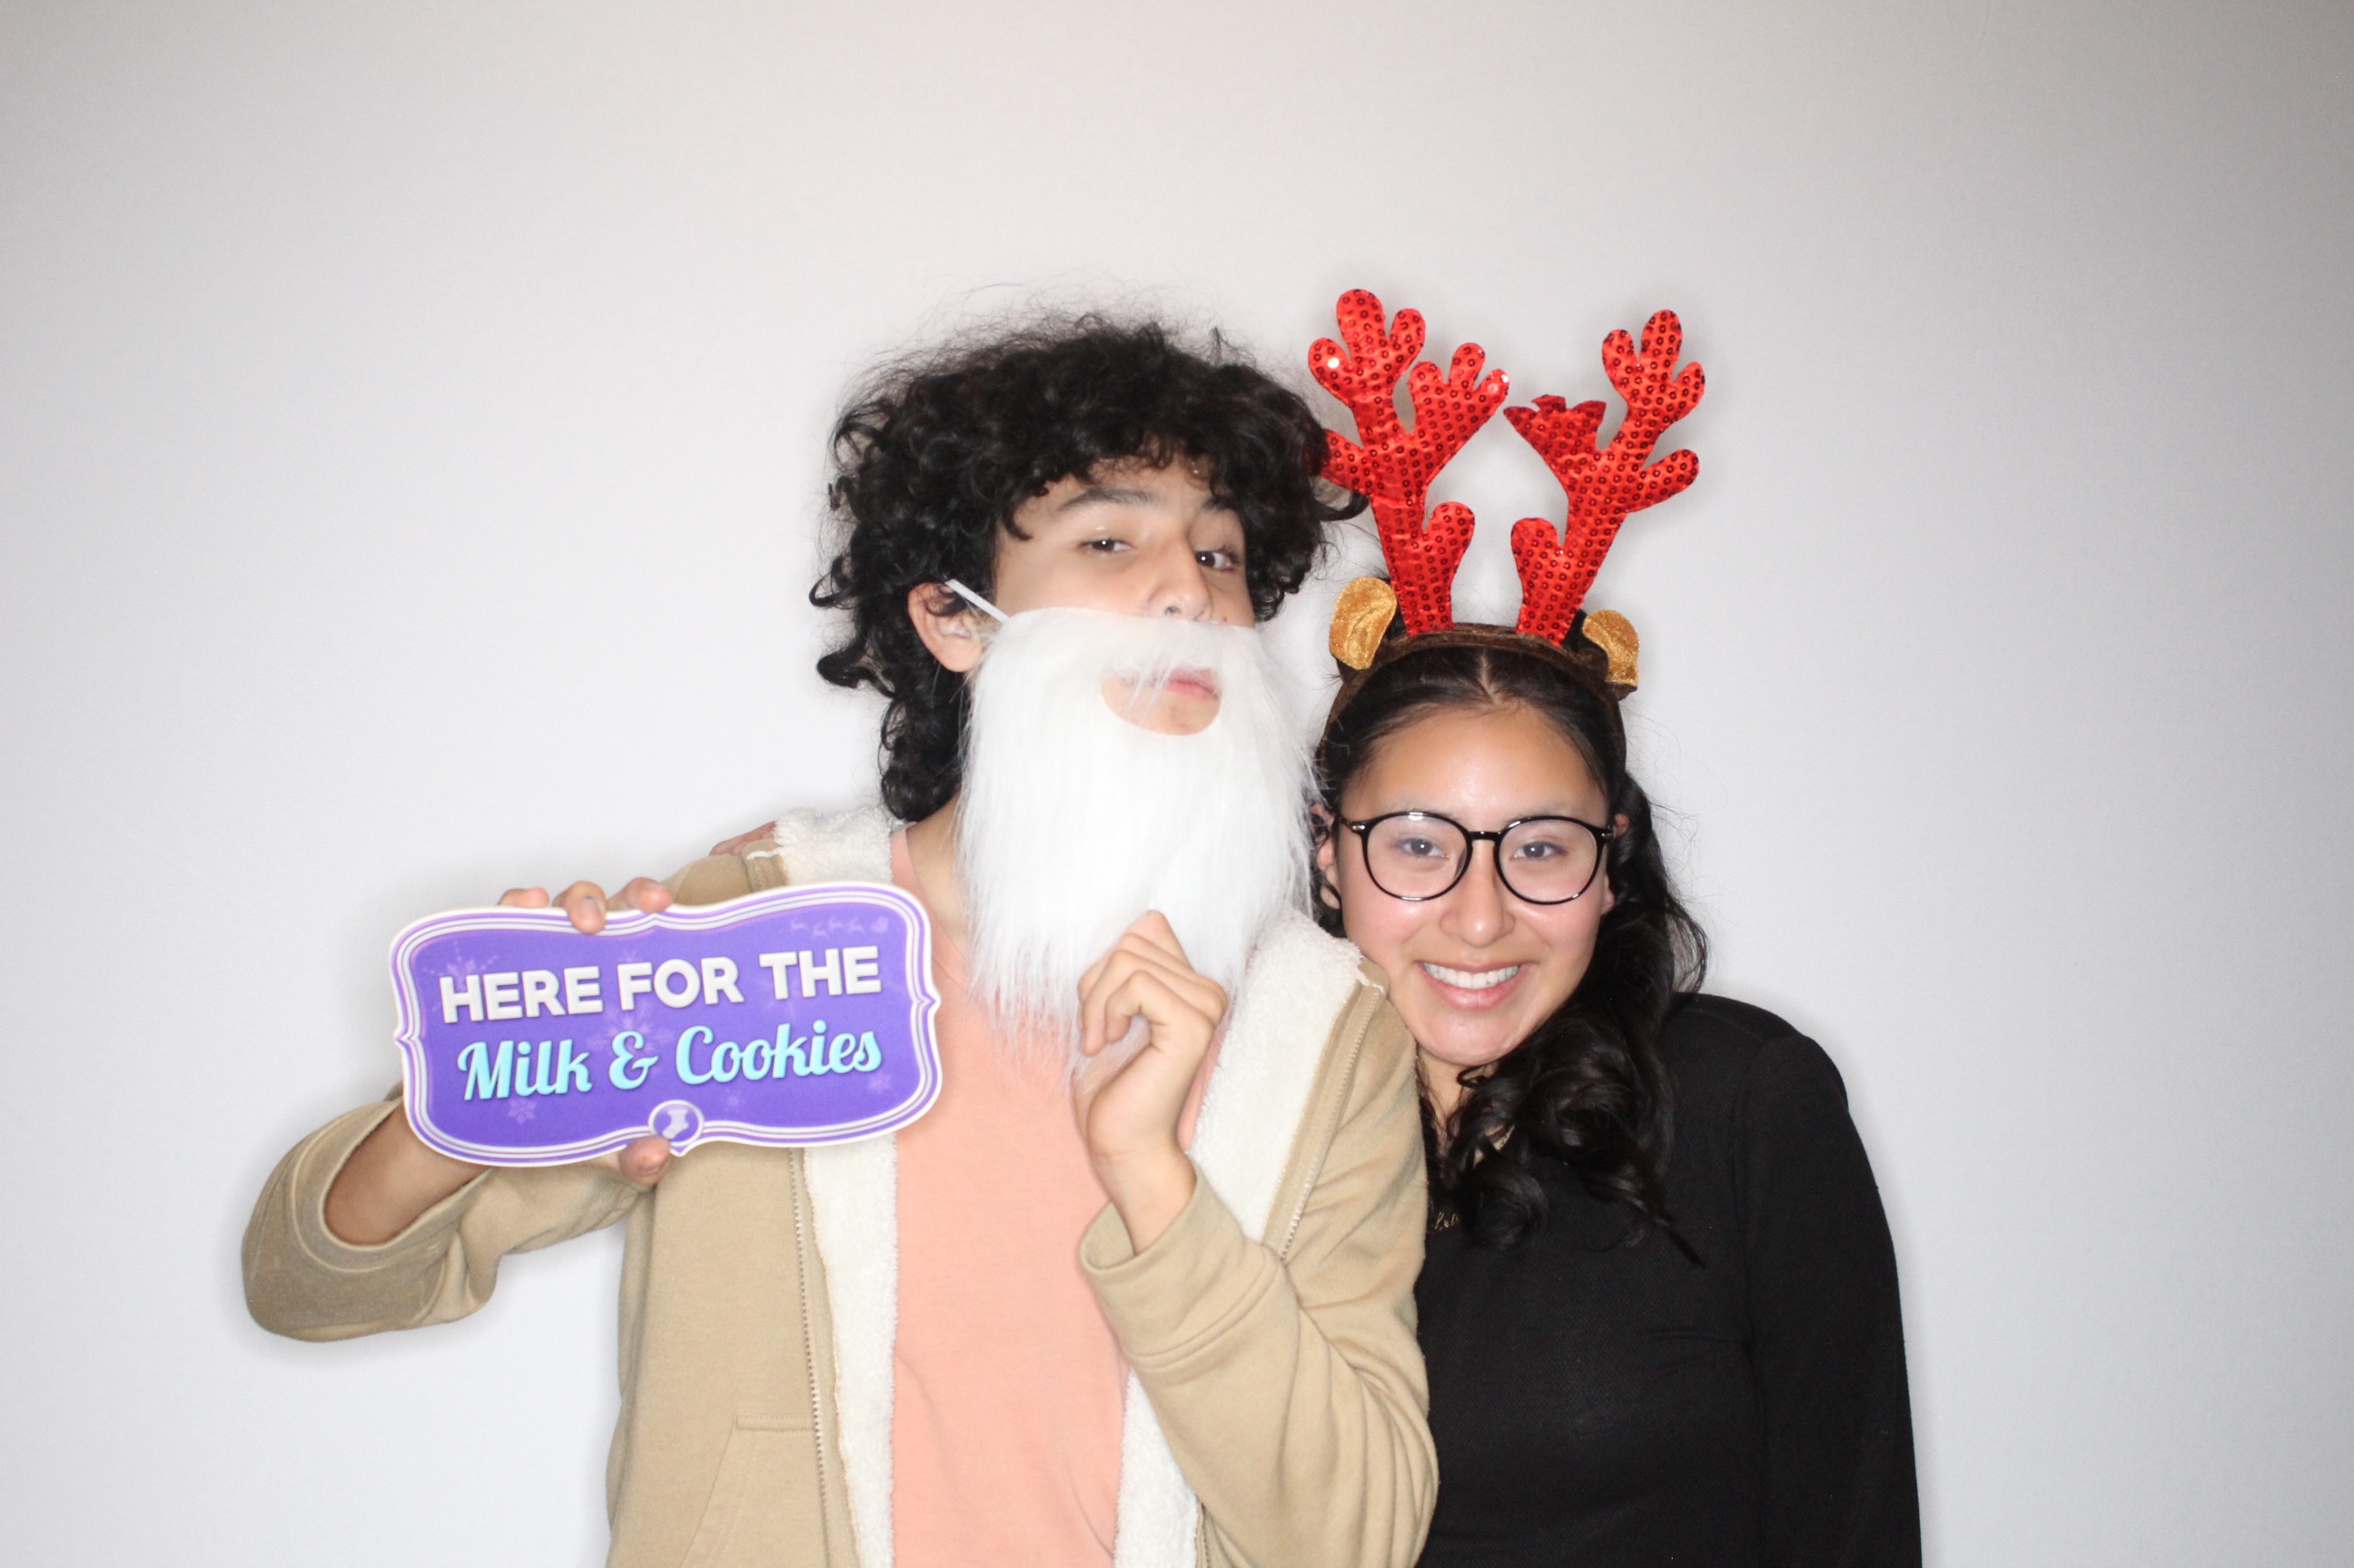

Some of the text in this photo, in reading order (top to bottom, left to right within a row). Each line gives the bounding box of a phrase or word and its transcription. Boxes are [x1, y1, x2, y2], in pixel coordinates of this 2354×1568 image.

[439, 945, 882, 1023] HERE FOR THE
[457, 1020, 882, 1100] Milk & Cookies
